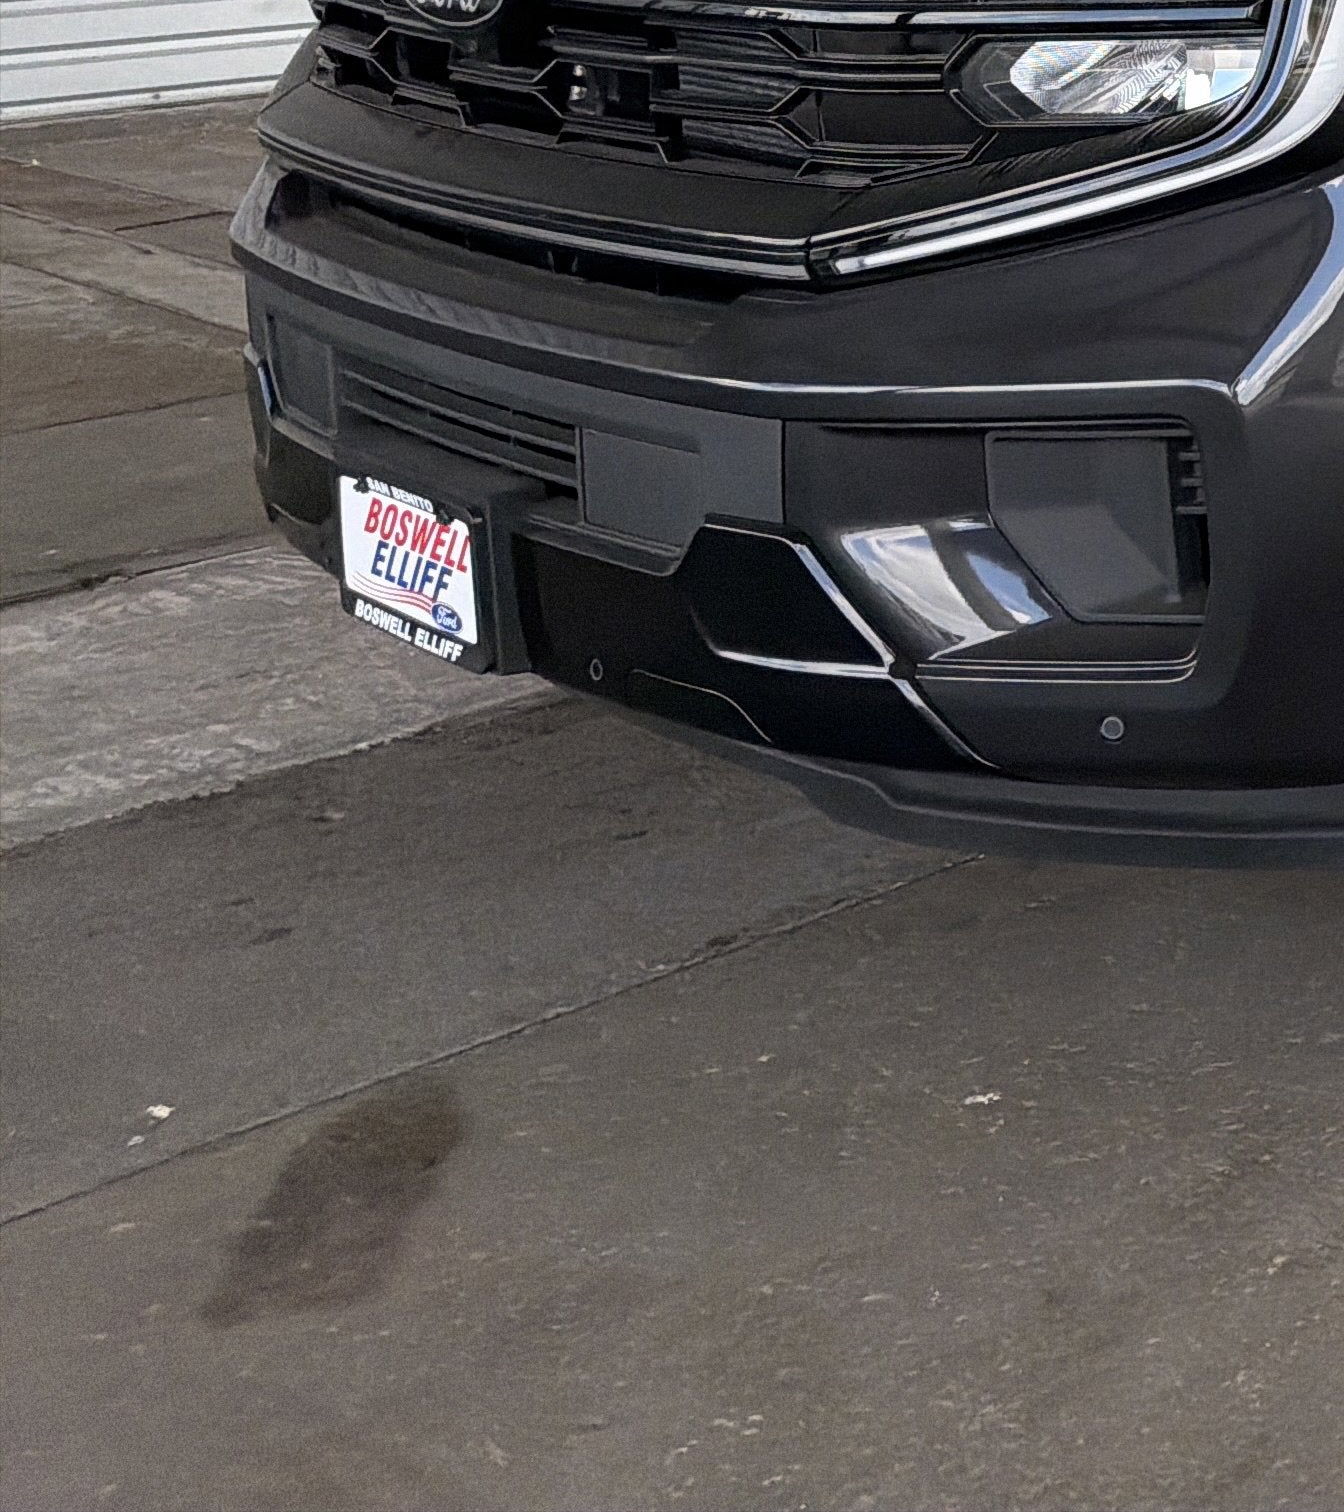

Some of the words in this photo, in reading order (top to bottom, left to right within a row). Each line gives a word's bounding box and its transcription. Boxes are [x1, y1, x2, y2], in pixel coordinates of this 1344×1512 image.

[366, 476, 390, 495] SAN
[392, 485, 434, 513] BENITO
[364, 497, 472, 574] BOSWELL
[370, 539, 453, 603] ELLIFF
[355, 599, 413, 642] BOSWELL
[414, 629, 464, 663] ELLIFF
[437, 605, 458, 631] Ford
